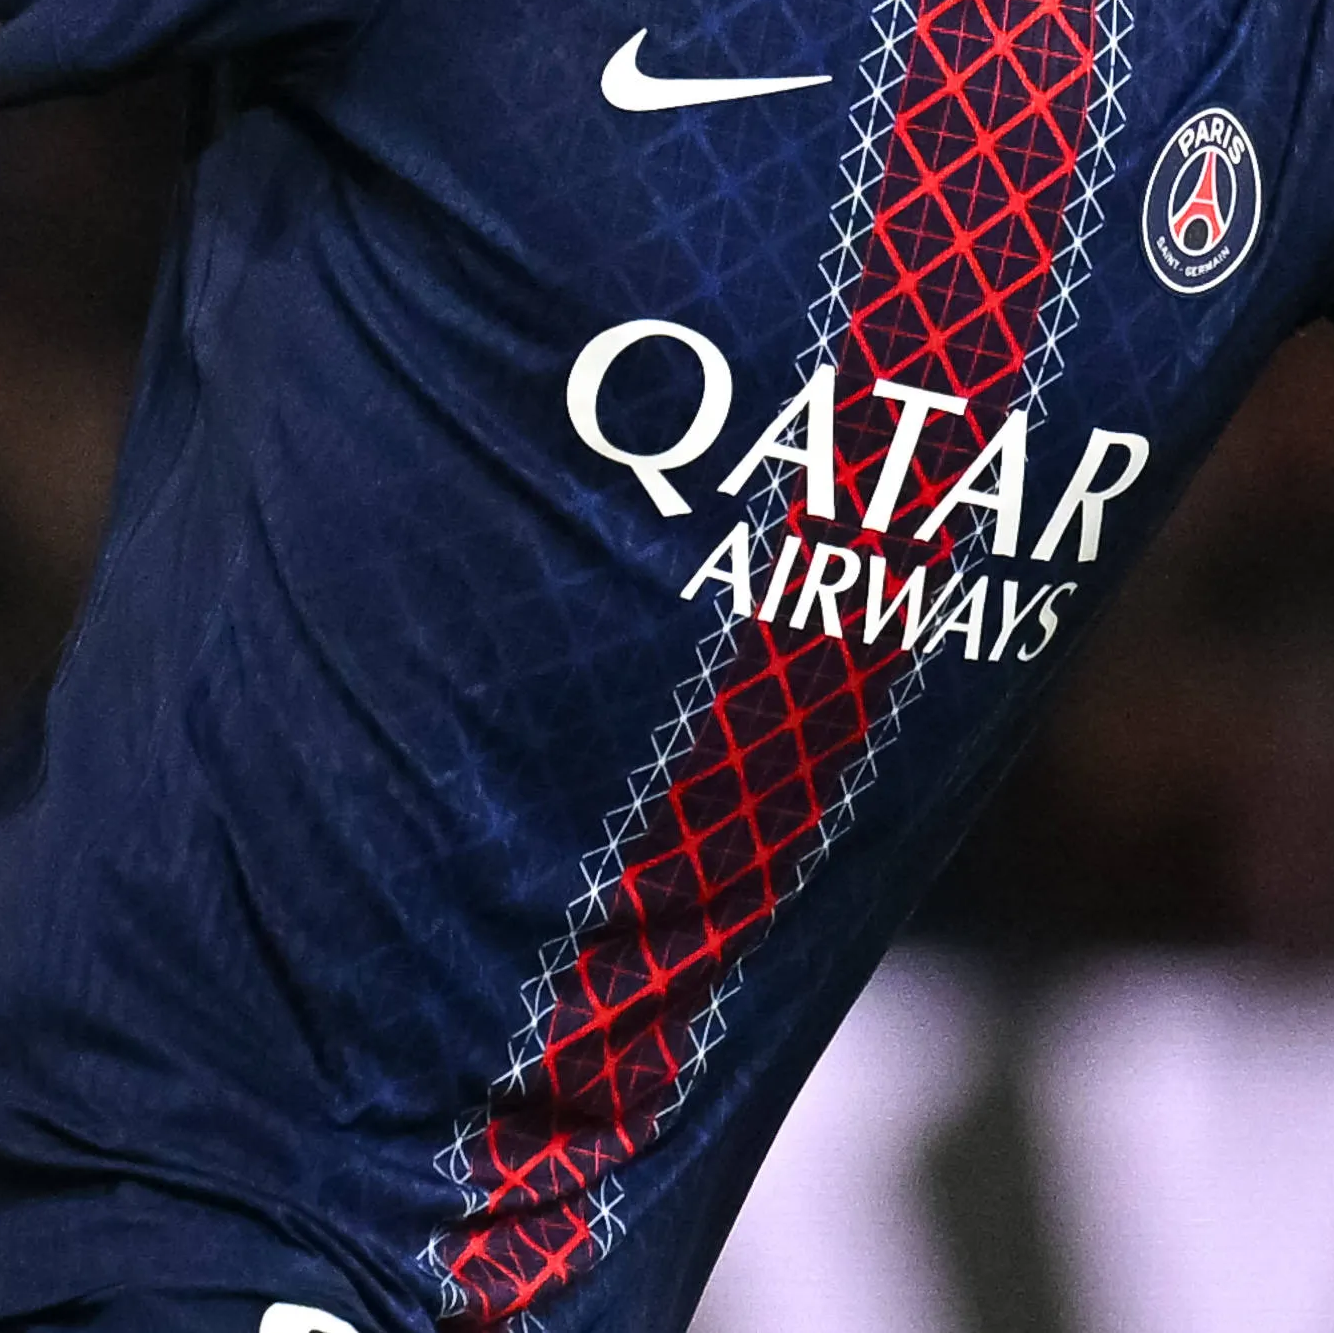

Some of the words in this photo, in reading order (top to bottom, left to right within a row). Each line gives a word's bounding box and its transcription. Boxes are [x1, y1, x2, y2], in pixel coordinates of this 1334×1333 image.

[1178, 118, 1246, 165] PARIS
[566, 318, 1150, 564] QATAR
[680, 521, 1078, 663] AIRWAYS
